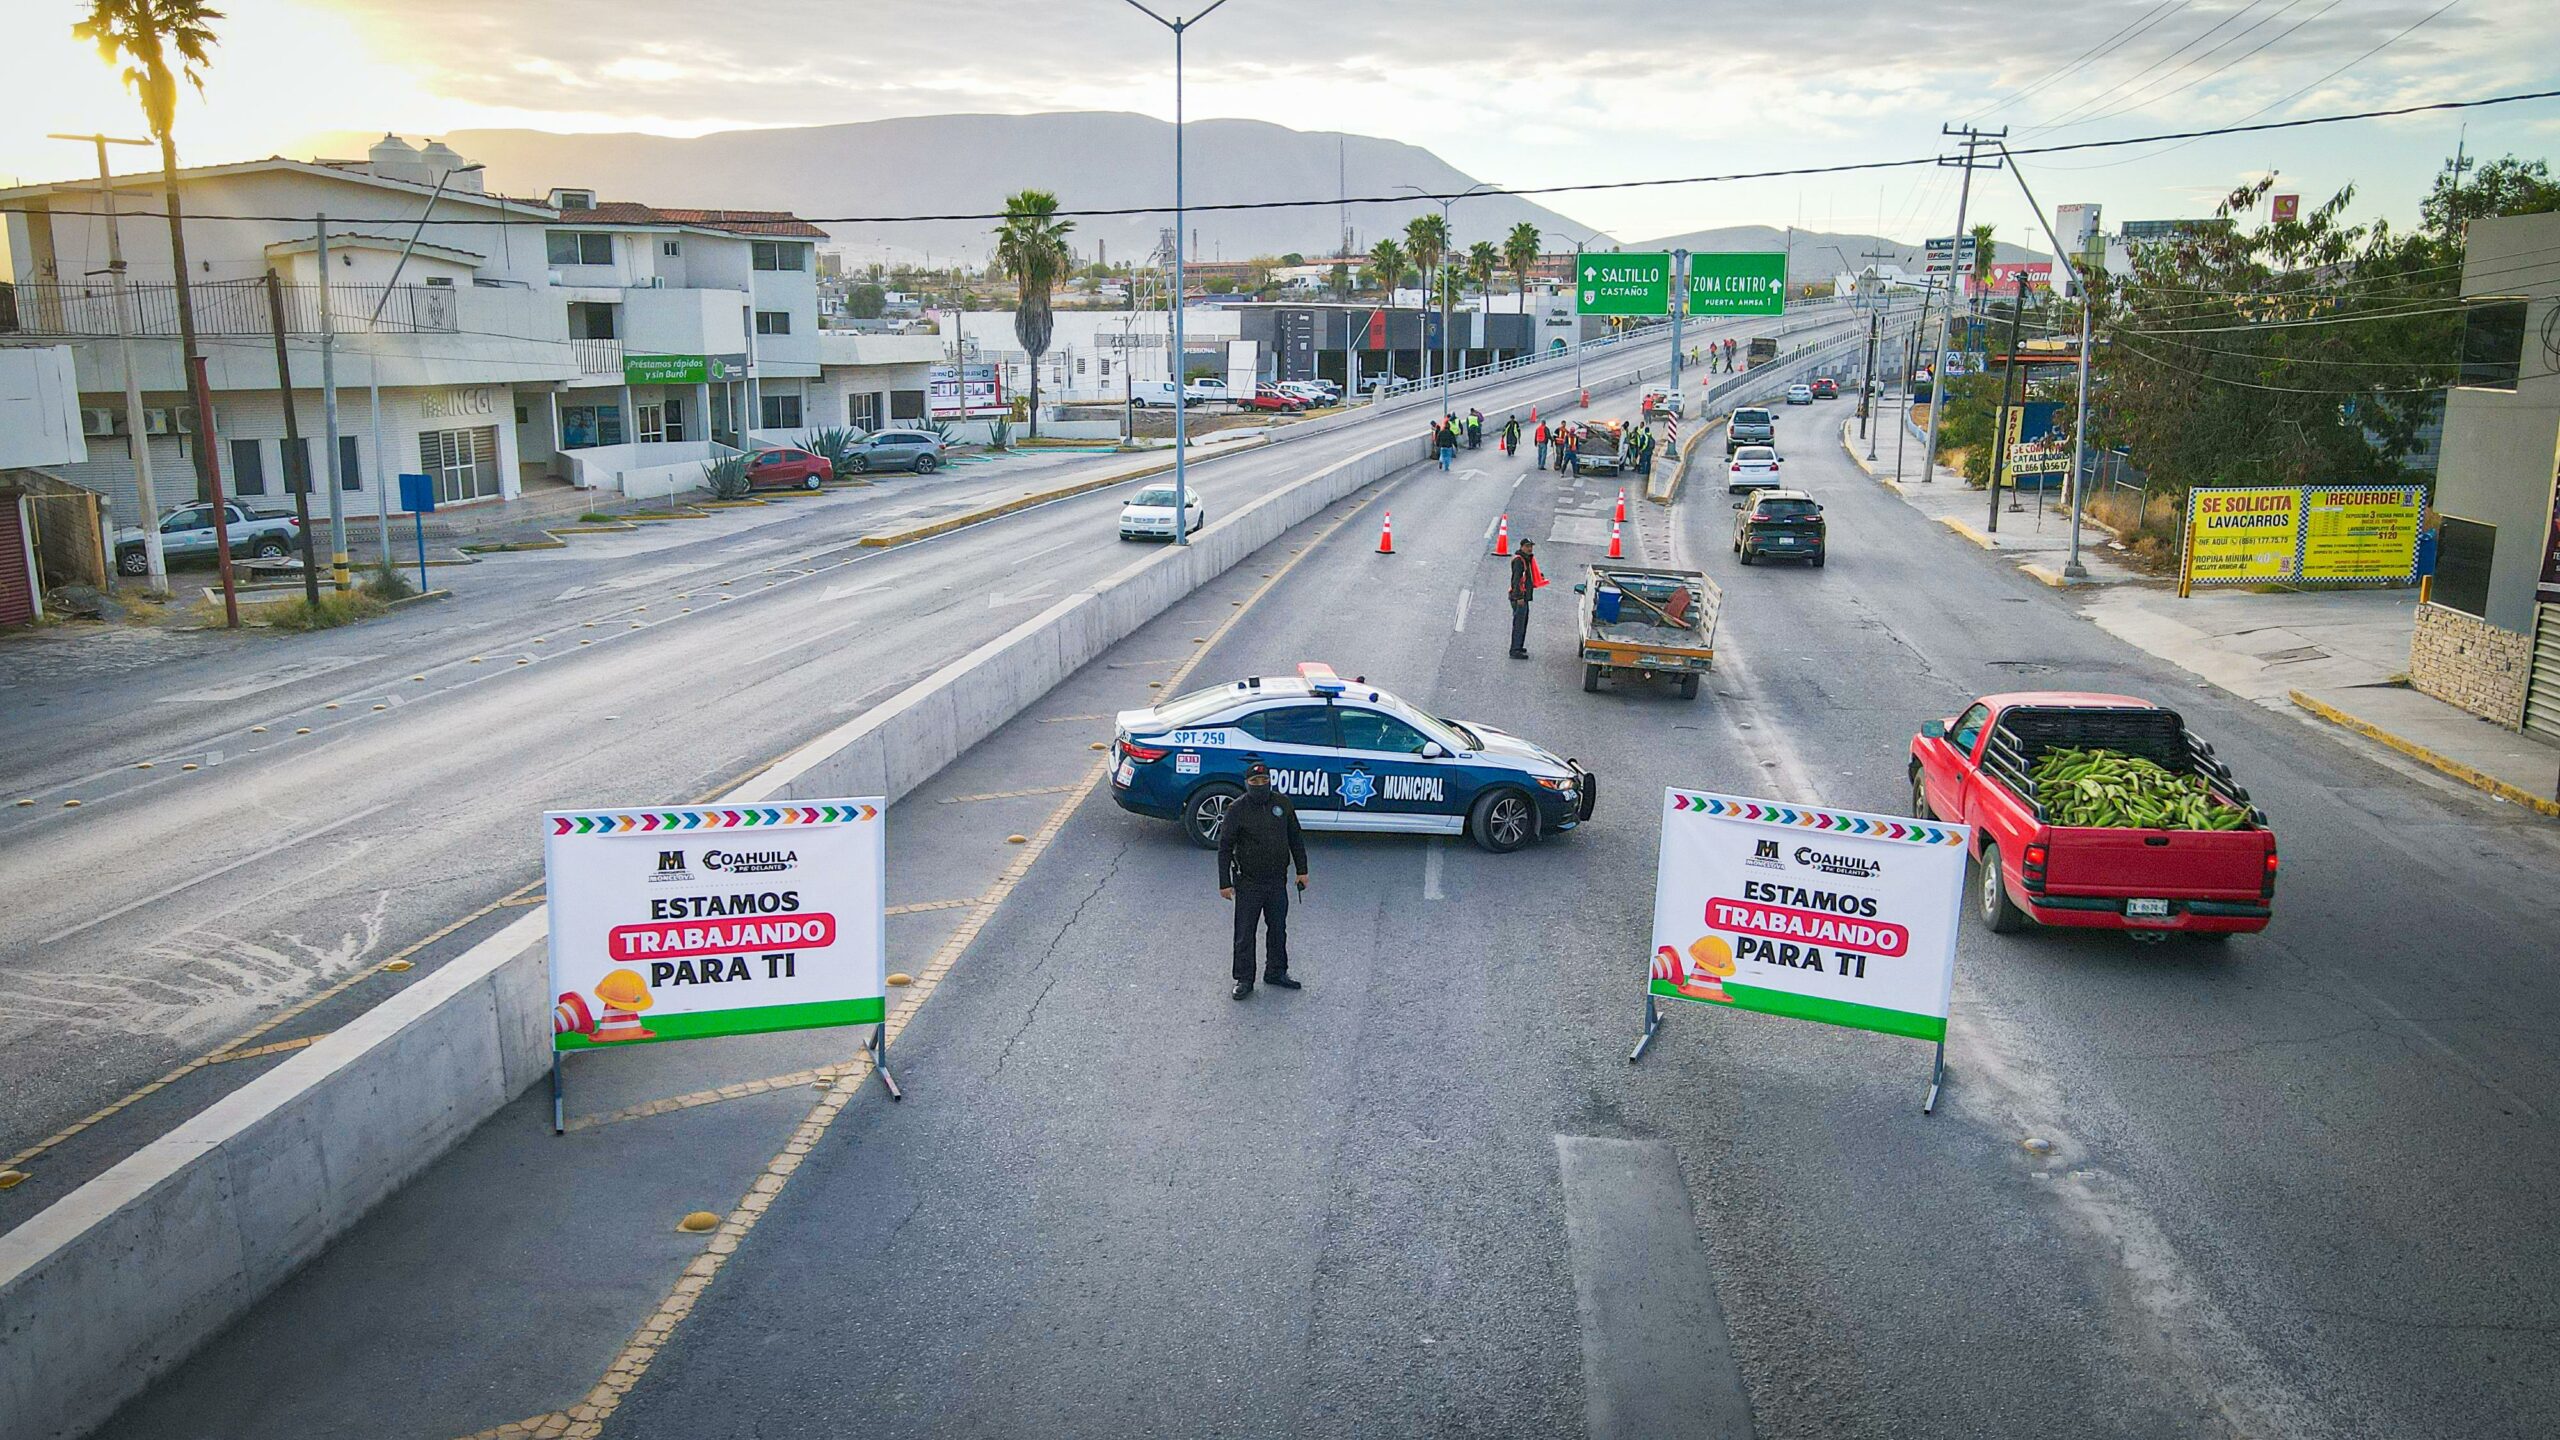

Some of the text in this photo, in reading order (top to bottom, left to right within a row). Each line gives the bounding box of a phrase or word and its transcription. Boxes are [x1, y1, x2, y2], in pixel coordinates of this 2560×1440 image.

[1601, 268, 1659, 283] SALTILLO
[1601, 286, 1649, 296] CASTAÑOS
[1693, 276, 1766, 292] ZONA CENTRO
[628, 360, 704, 370] ¡Préstamos rápidos
[645, 369, 687, 380] y sin Buró!
[2202, 496, 2292, 513] SE SOLICITA
[2326, 492, 2400, 506] ¡RECUERDE!
[2208, 514, 2289, 528] LAVACARROS
[2370, 510, 2376, 518] 3
[1174, 732, 1225, 744] SPT-259
[1269, 768, 1444, 802] POLICÍA MUNICIPAL
[702, 850, 798, 870] COAHUILA
[1794, 847, 1880, 871] COAHUILA
[751, 864, 783, 872] DELANTE
[651, 891, 800, 920] ESTAMOS
[1744, 880, 1878, 918] ESTAMOS
[1715, 904, 1898, 950] TRABAJANDO
[620, 920, 826, 954] TRABAJANDO
[1736, 936, 1867, 978] PARA TI
[651, 952, 796, 988] PARA TI
